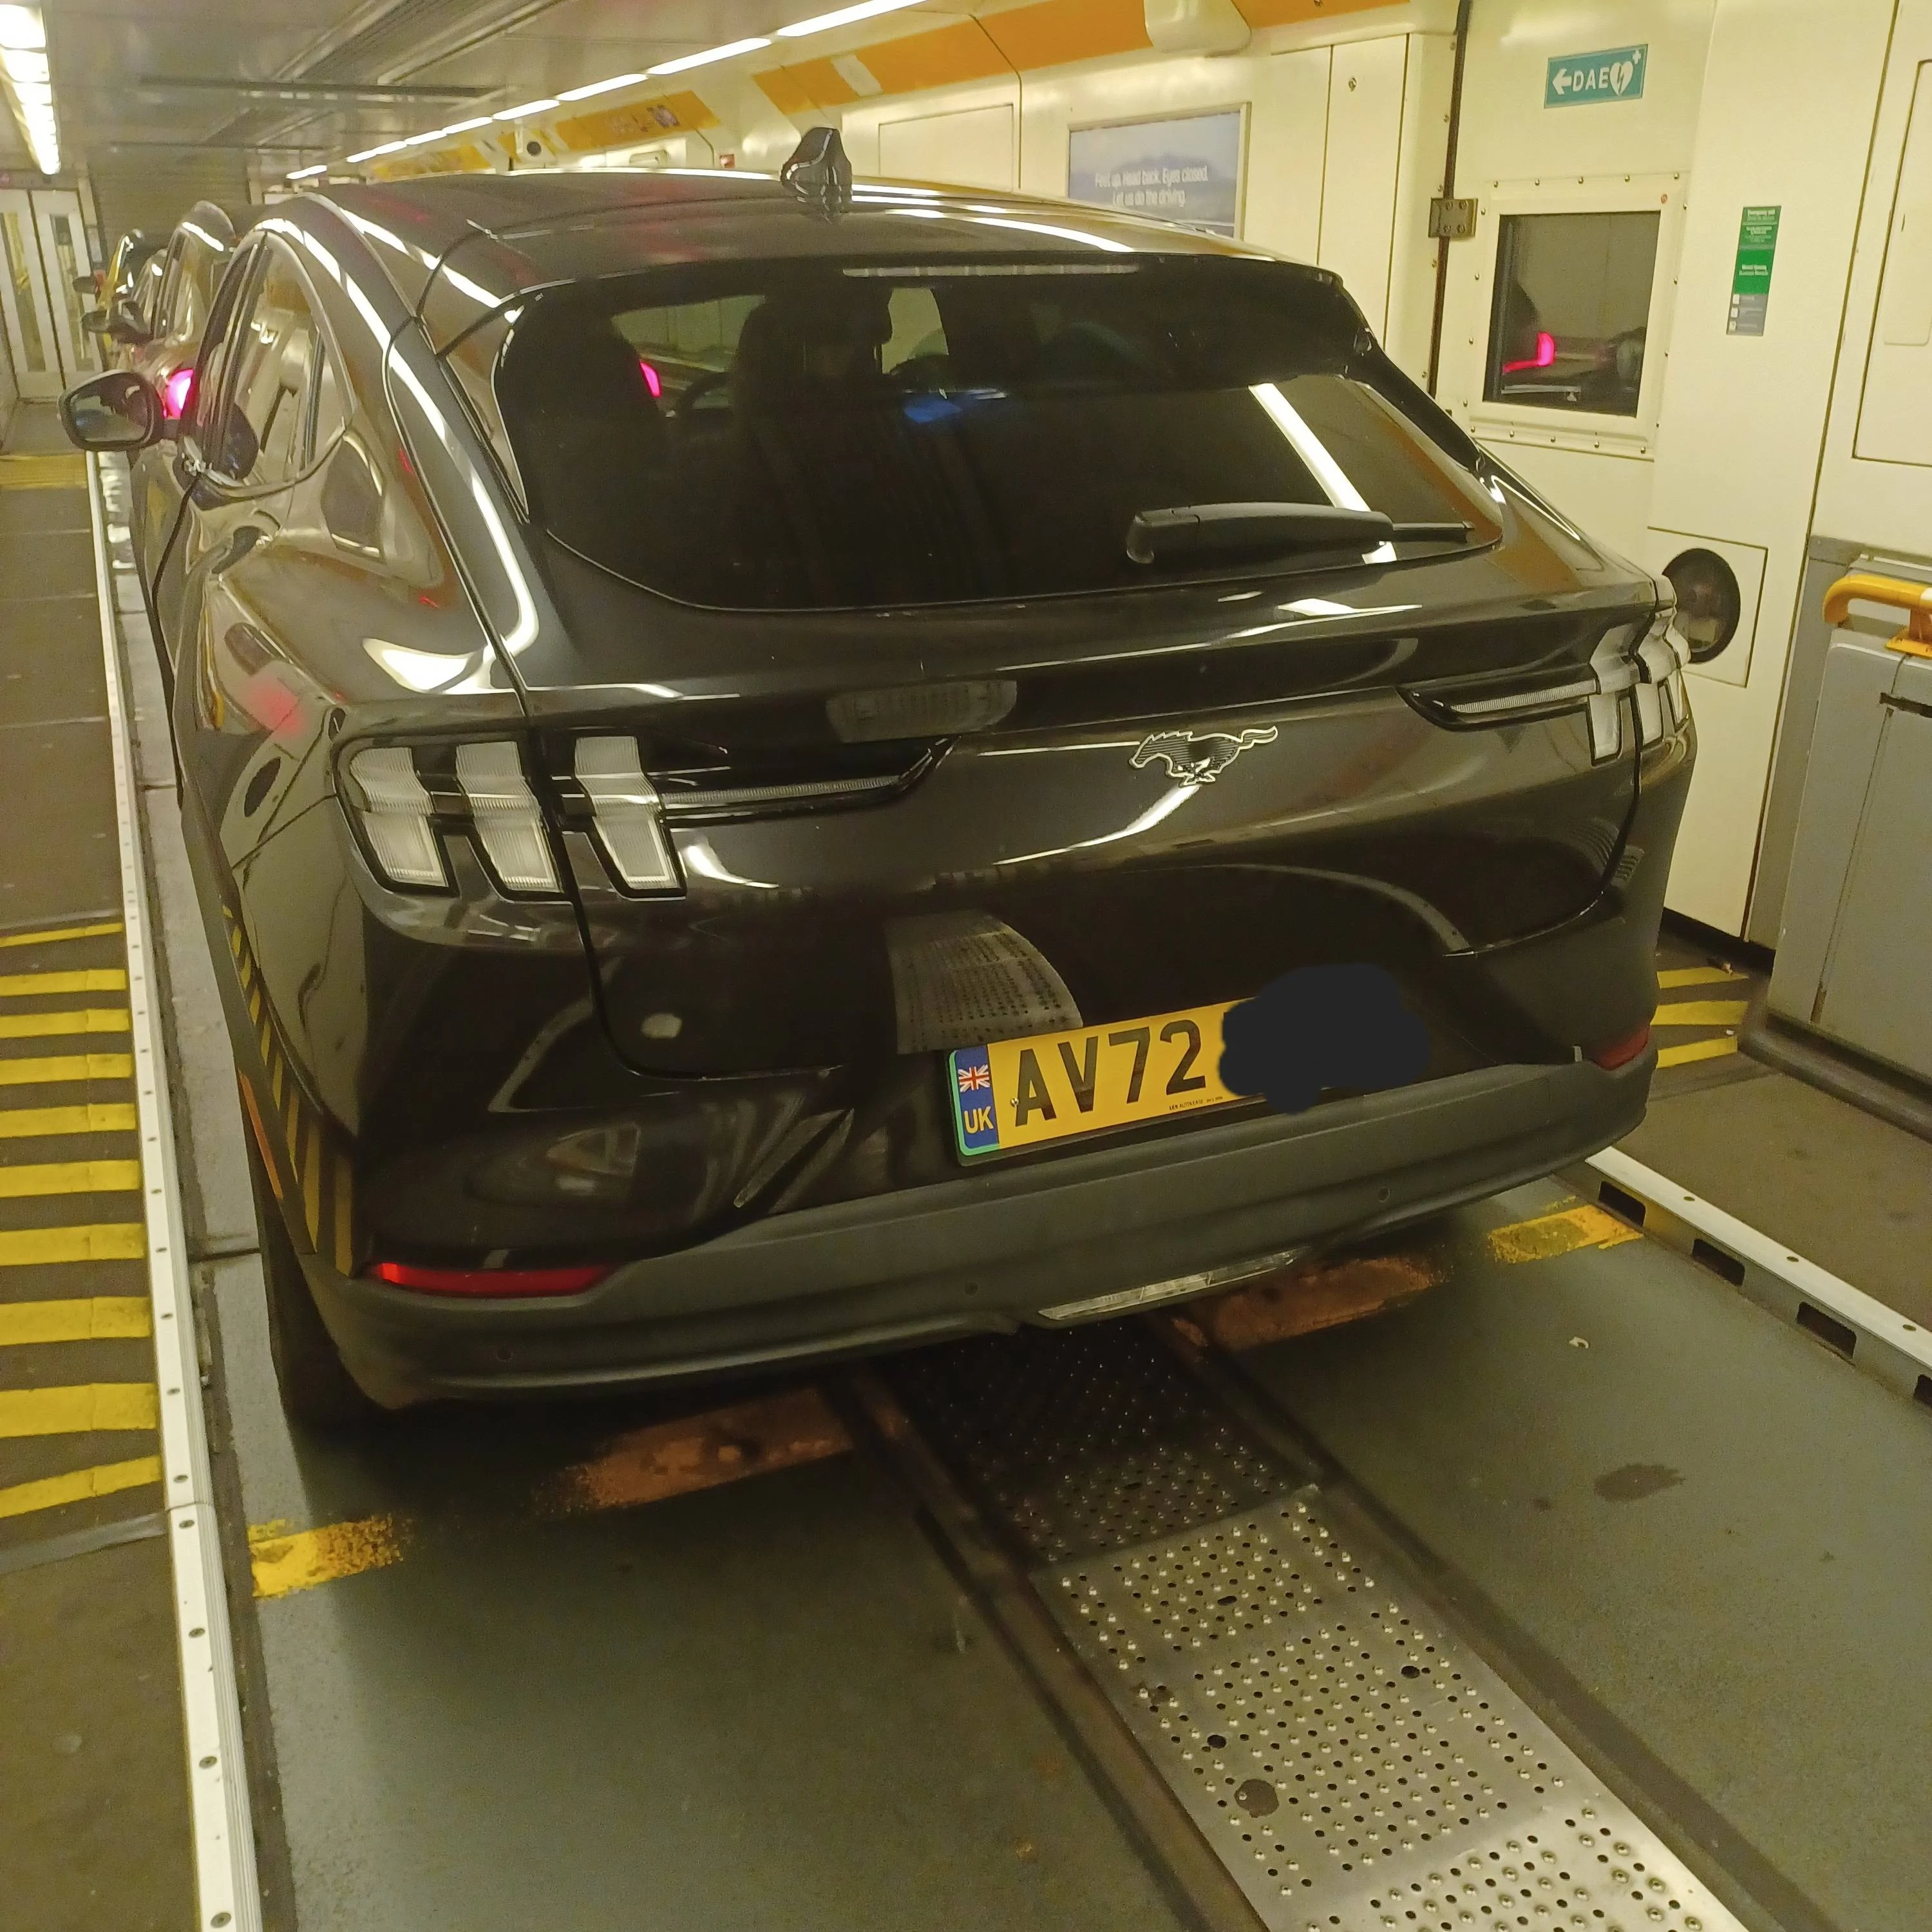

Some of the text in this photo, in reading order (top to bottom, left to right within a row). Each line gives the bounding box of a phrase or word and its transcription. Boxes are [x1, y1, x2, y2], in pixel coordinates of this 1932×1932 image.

[1573, 66, 1610, 92] DAE
[1015, 1019, 1206, 1127] AV72
[964, 1106, 994, 1133] UK
